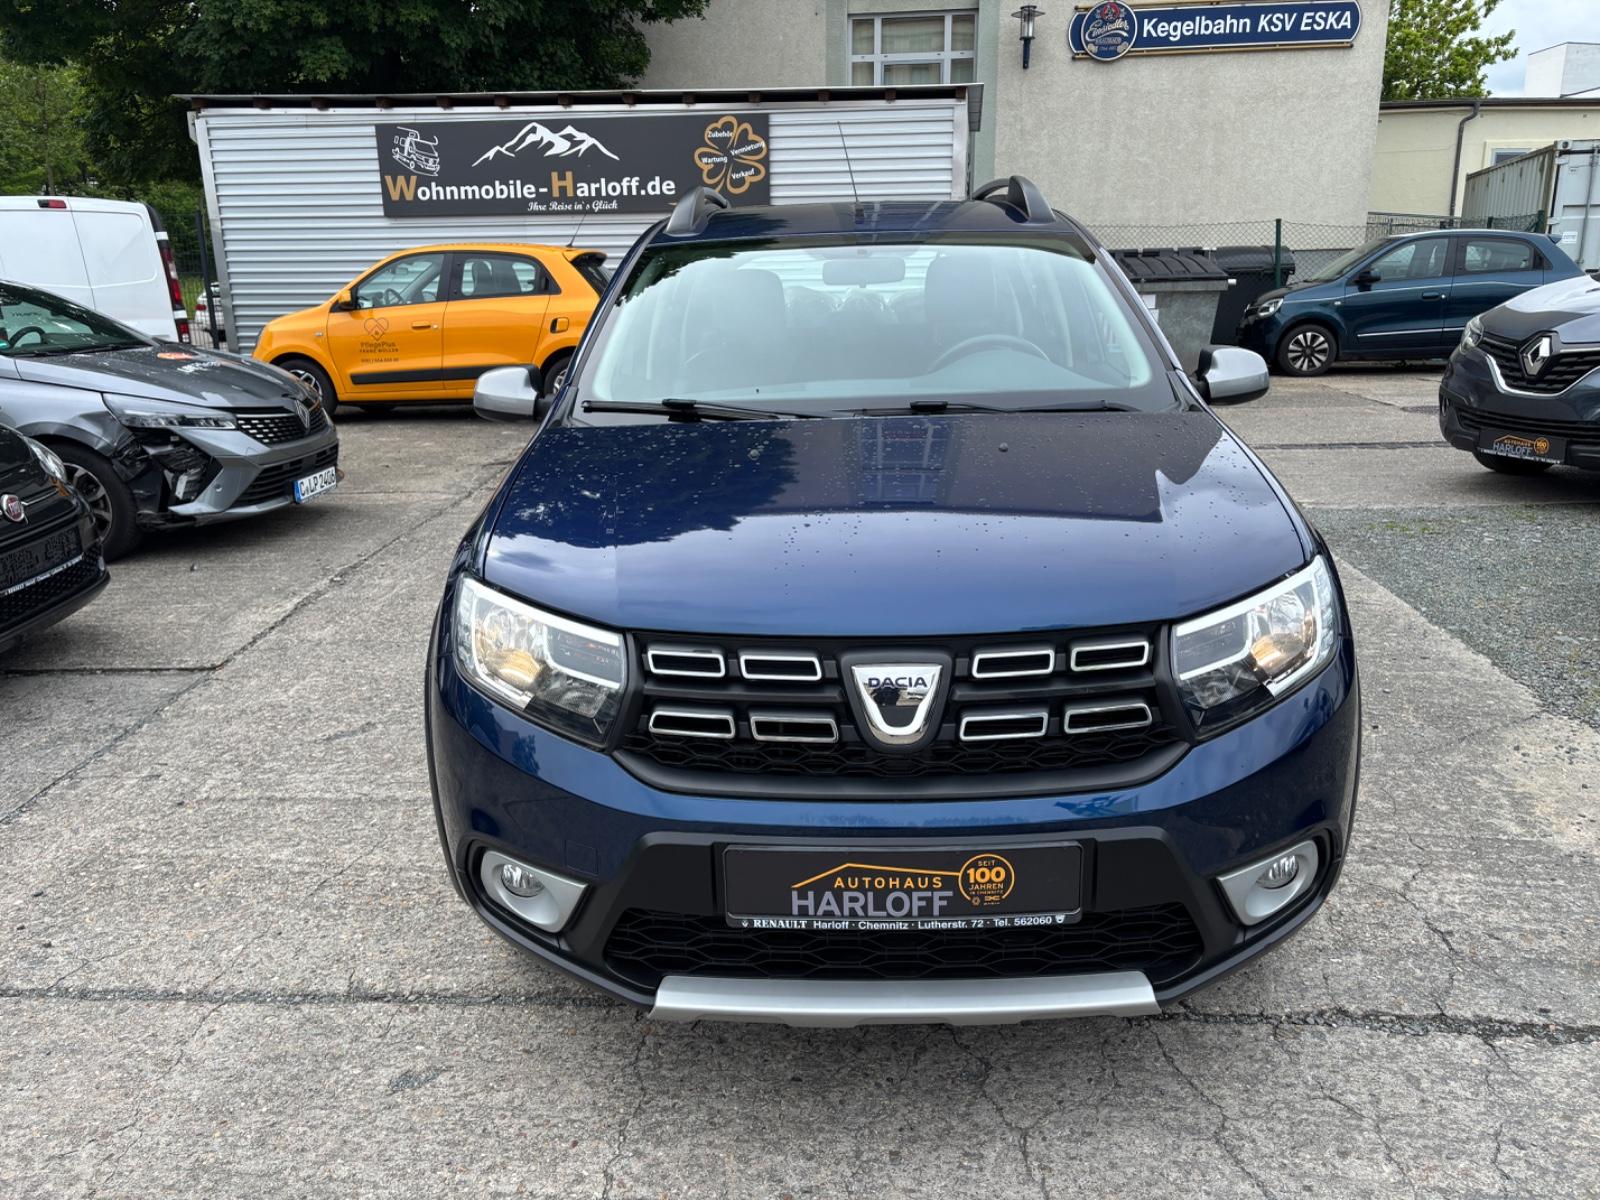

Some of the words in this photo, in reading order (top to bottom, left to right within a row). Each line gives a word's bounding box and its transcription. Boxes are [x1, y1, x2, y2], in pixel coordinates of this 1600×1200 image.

[1143, 15, 1250, 41] Kegelbahn
[1257, 12, 1297, 32] KSV
[1300, 10, 1352, 31] ESKA
[731, 141, 765, 155] Vermietung
[731, 168, 754, 179] Verkauf
[384, 170, 676, 201] Wohnmobile-Harloff.de
[527, 202, 547, 212] Ihre
[549, 200, 573, 211] Reise
[592, 200, 618, 212] Glück
[1492, 442, 1533, 456] HARLOFF
[868, 676, 928, 688] DACIA
[966, 866, 1006, 883] 100
[834, 877, 943, 889] AUTOHAUS
[968, 883, 1004, 891] JAHREN
[791, 890, 953, 917] HARLOFF
[753, 919, 807, 929] RENAULT
[813, 920, 849, 930] Harloff
[858, 920, 909, 930] Chemnitz
[917, 919, 968, 929] Lutherstr.
[971, 919, 984, 928] 72
[993, 917, 1011, 927] Tel.
[1013, 915, 1053, 926] 562060
